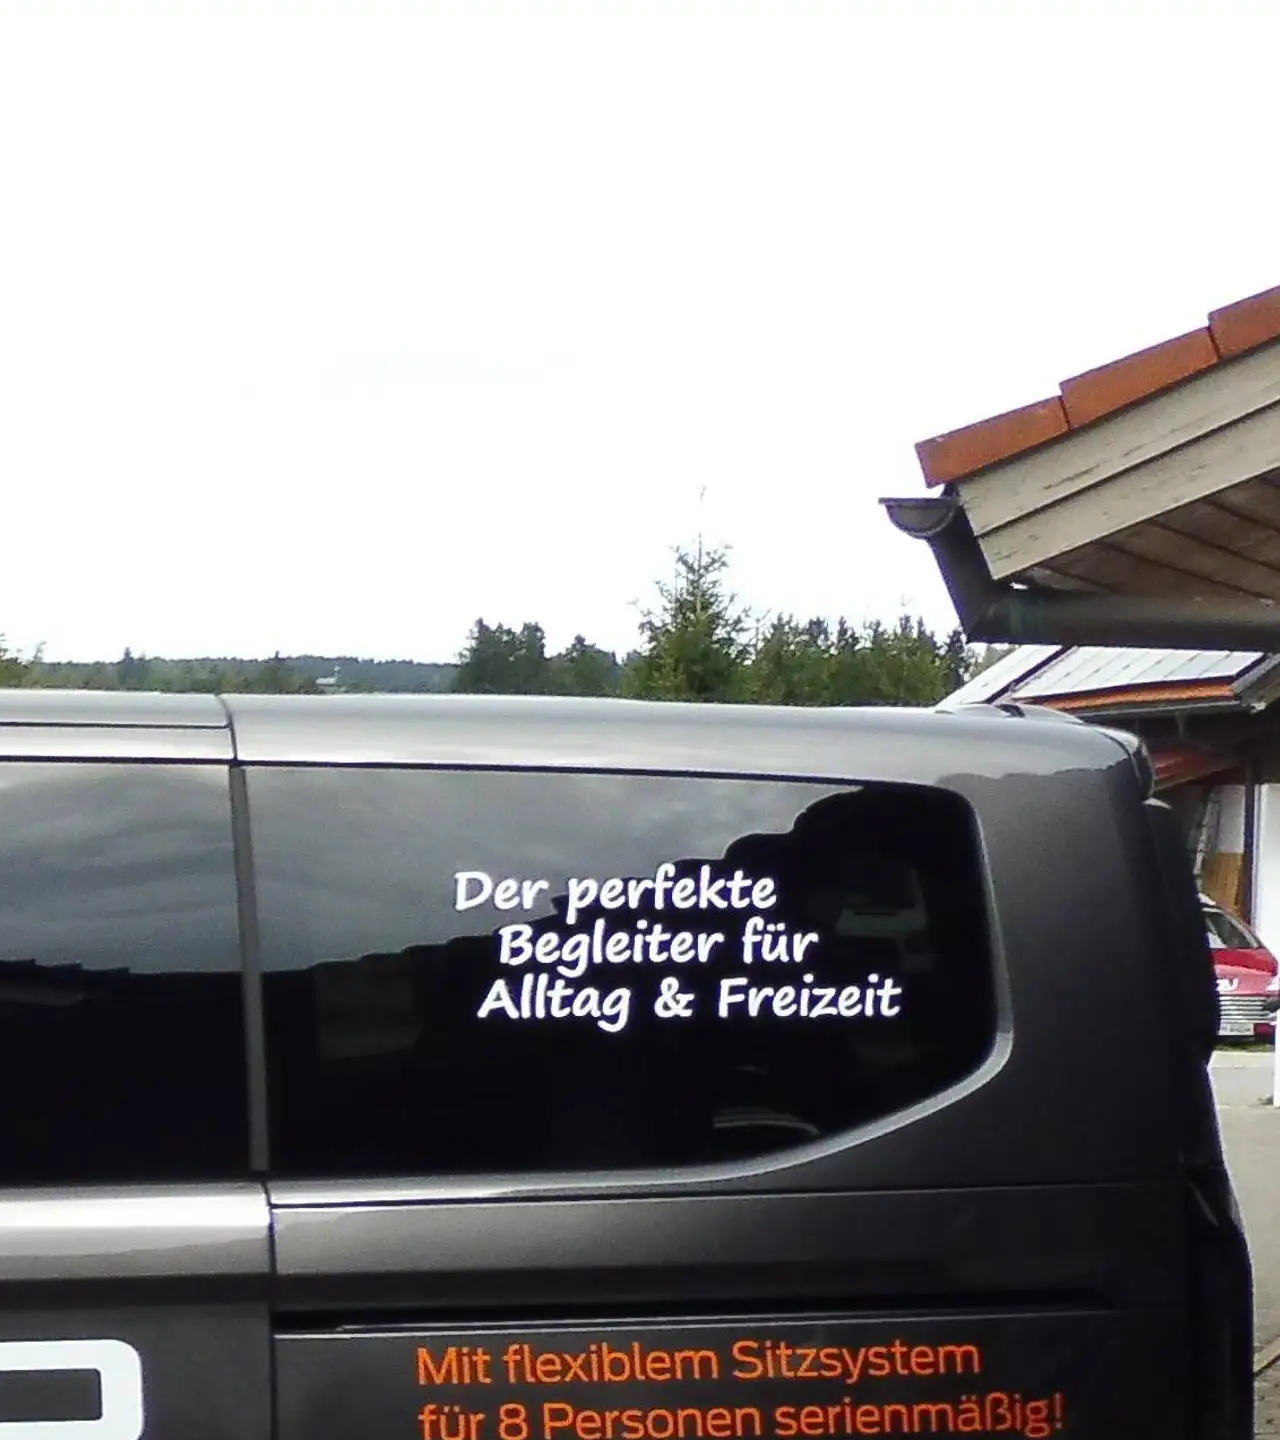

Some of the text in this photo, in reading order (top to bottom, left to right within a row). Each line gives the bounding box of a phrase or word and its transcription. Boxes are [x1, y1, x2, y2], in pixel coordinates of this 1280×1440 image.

[453, 863, 778, 924] Der perfekte
[498, 916, 820, 978] Begleiter für
[476, 973, 903, 1033] Alltag & Freizeit
[415, 1338, 982, 1386] Mit flexiblem Sitzsystem
[774, 1392, 1065, 1439] serienmäßig!
